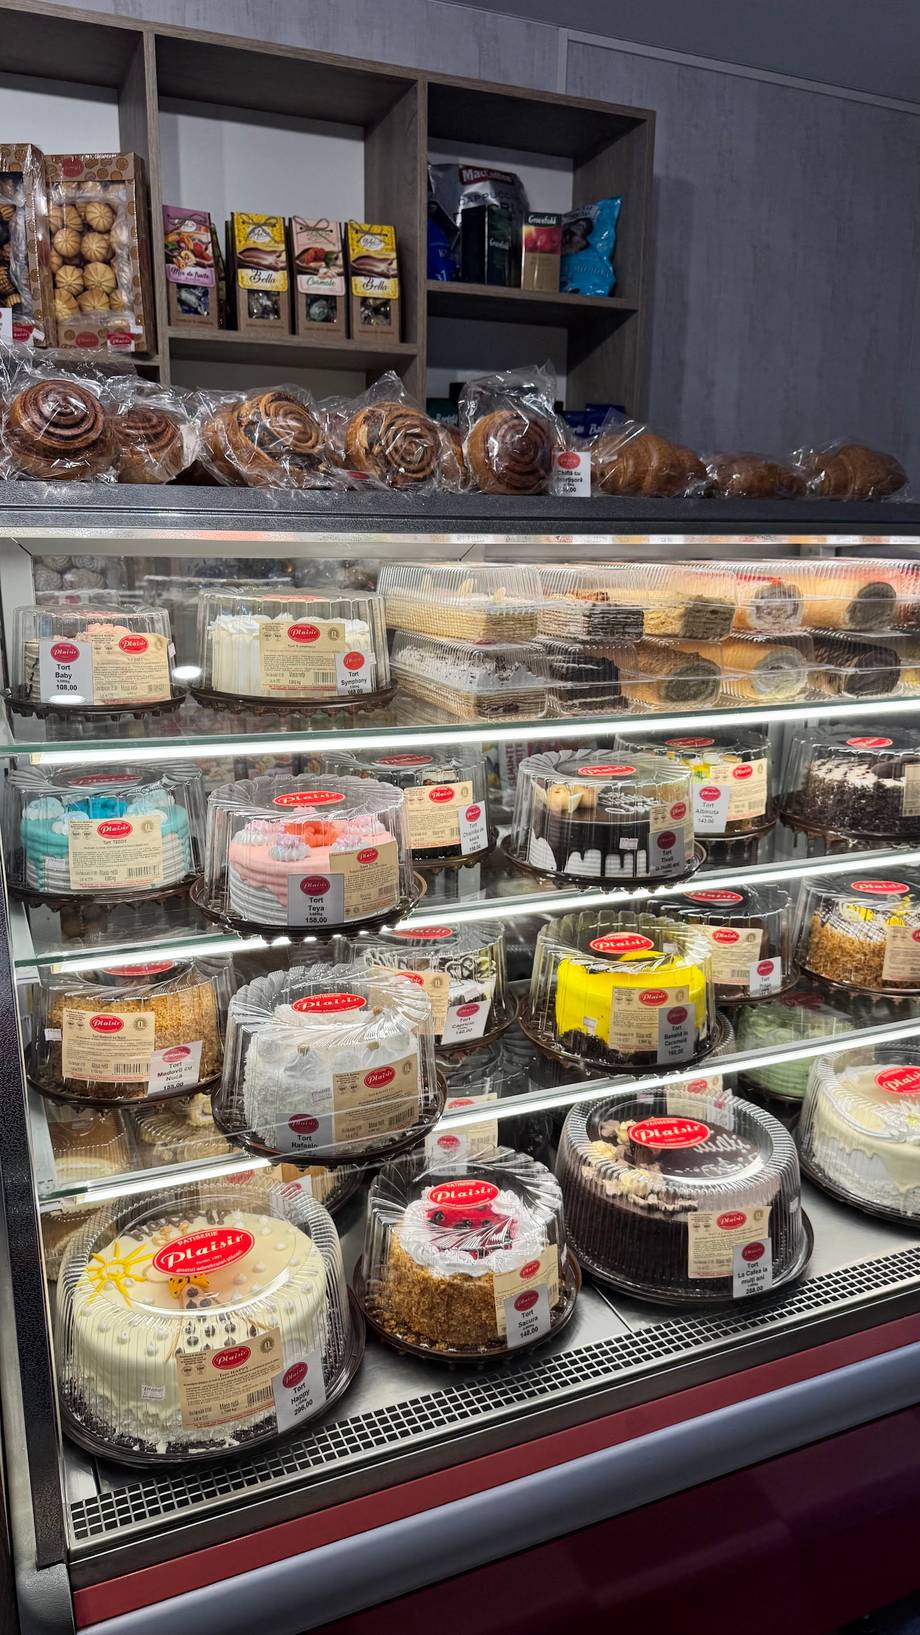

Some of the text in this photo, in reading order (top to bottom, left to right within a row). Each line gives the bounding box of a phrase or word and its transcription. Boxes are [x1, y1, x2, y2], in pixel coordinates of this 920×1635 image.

[292, 628, 317, 637] Plaisir
[57, 663, 71, 671] Tort
[55, 672, 73, 680] Baby
[341, 677, 367, 686] Symphony
[100, 824, 129, 835] Plaisir
[309, 896, 324, 904] Tort
[308, 904, 325, 912] Teya
[594, 938, 647, 949] Plaisir
[297, 997, 360, 1010] Plaisir
[92, 1019, 121, 1028] Plaisir
[168, 1061, 182, 1069] Tort
[366, 1070, 393, 1084] Plaisir
[297, 1134, 312, 1142] Tort
[634, 1124, 700, 1142] Plaisir
[432, 1186, 494, 1202] Plaisir
[720, 1214, 743, 1226] Plaisir
[160, 1233, 244, 1269] Plaisir
[746, 1260, 759, 1269] Tort
[521, 1308, 534, 1319] Tort
[518, 1315, 538, 1328] Sacura
[216, 1350, 248, 1366] Plaisir
[292, 1381, 306, 1394] Tort
[291, 1389, 310, 1405] Happy
